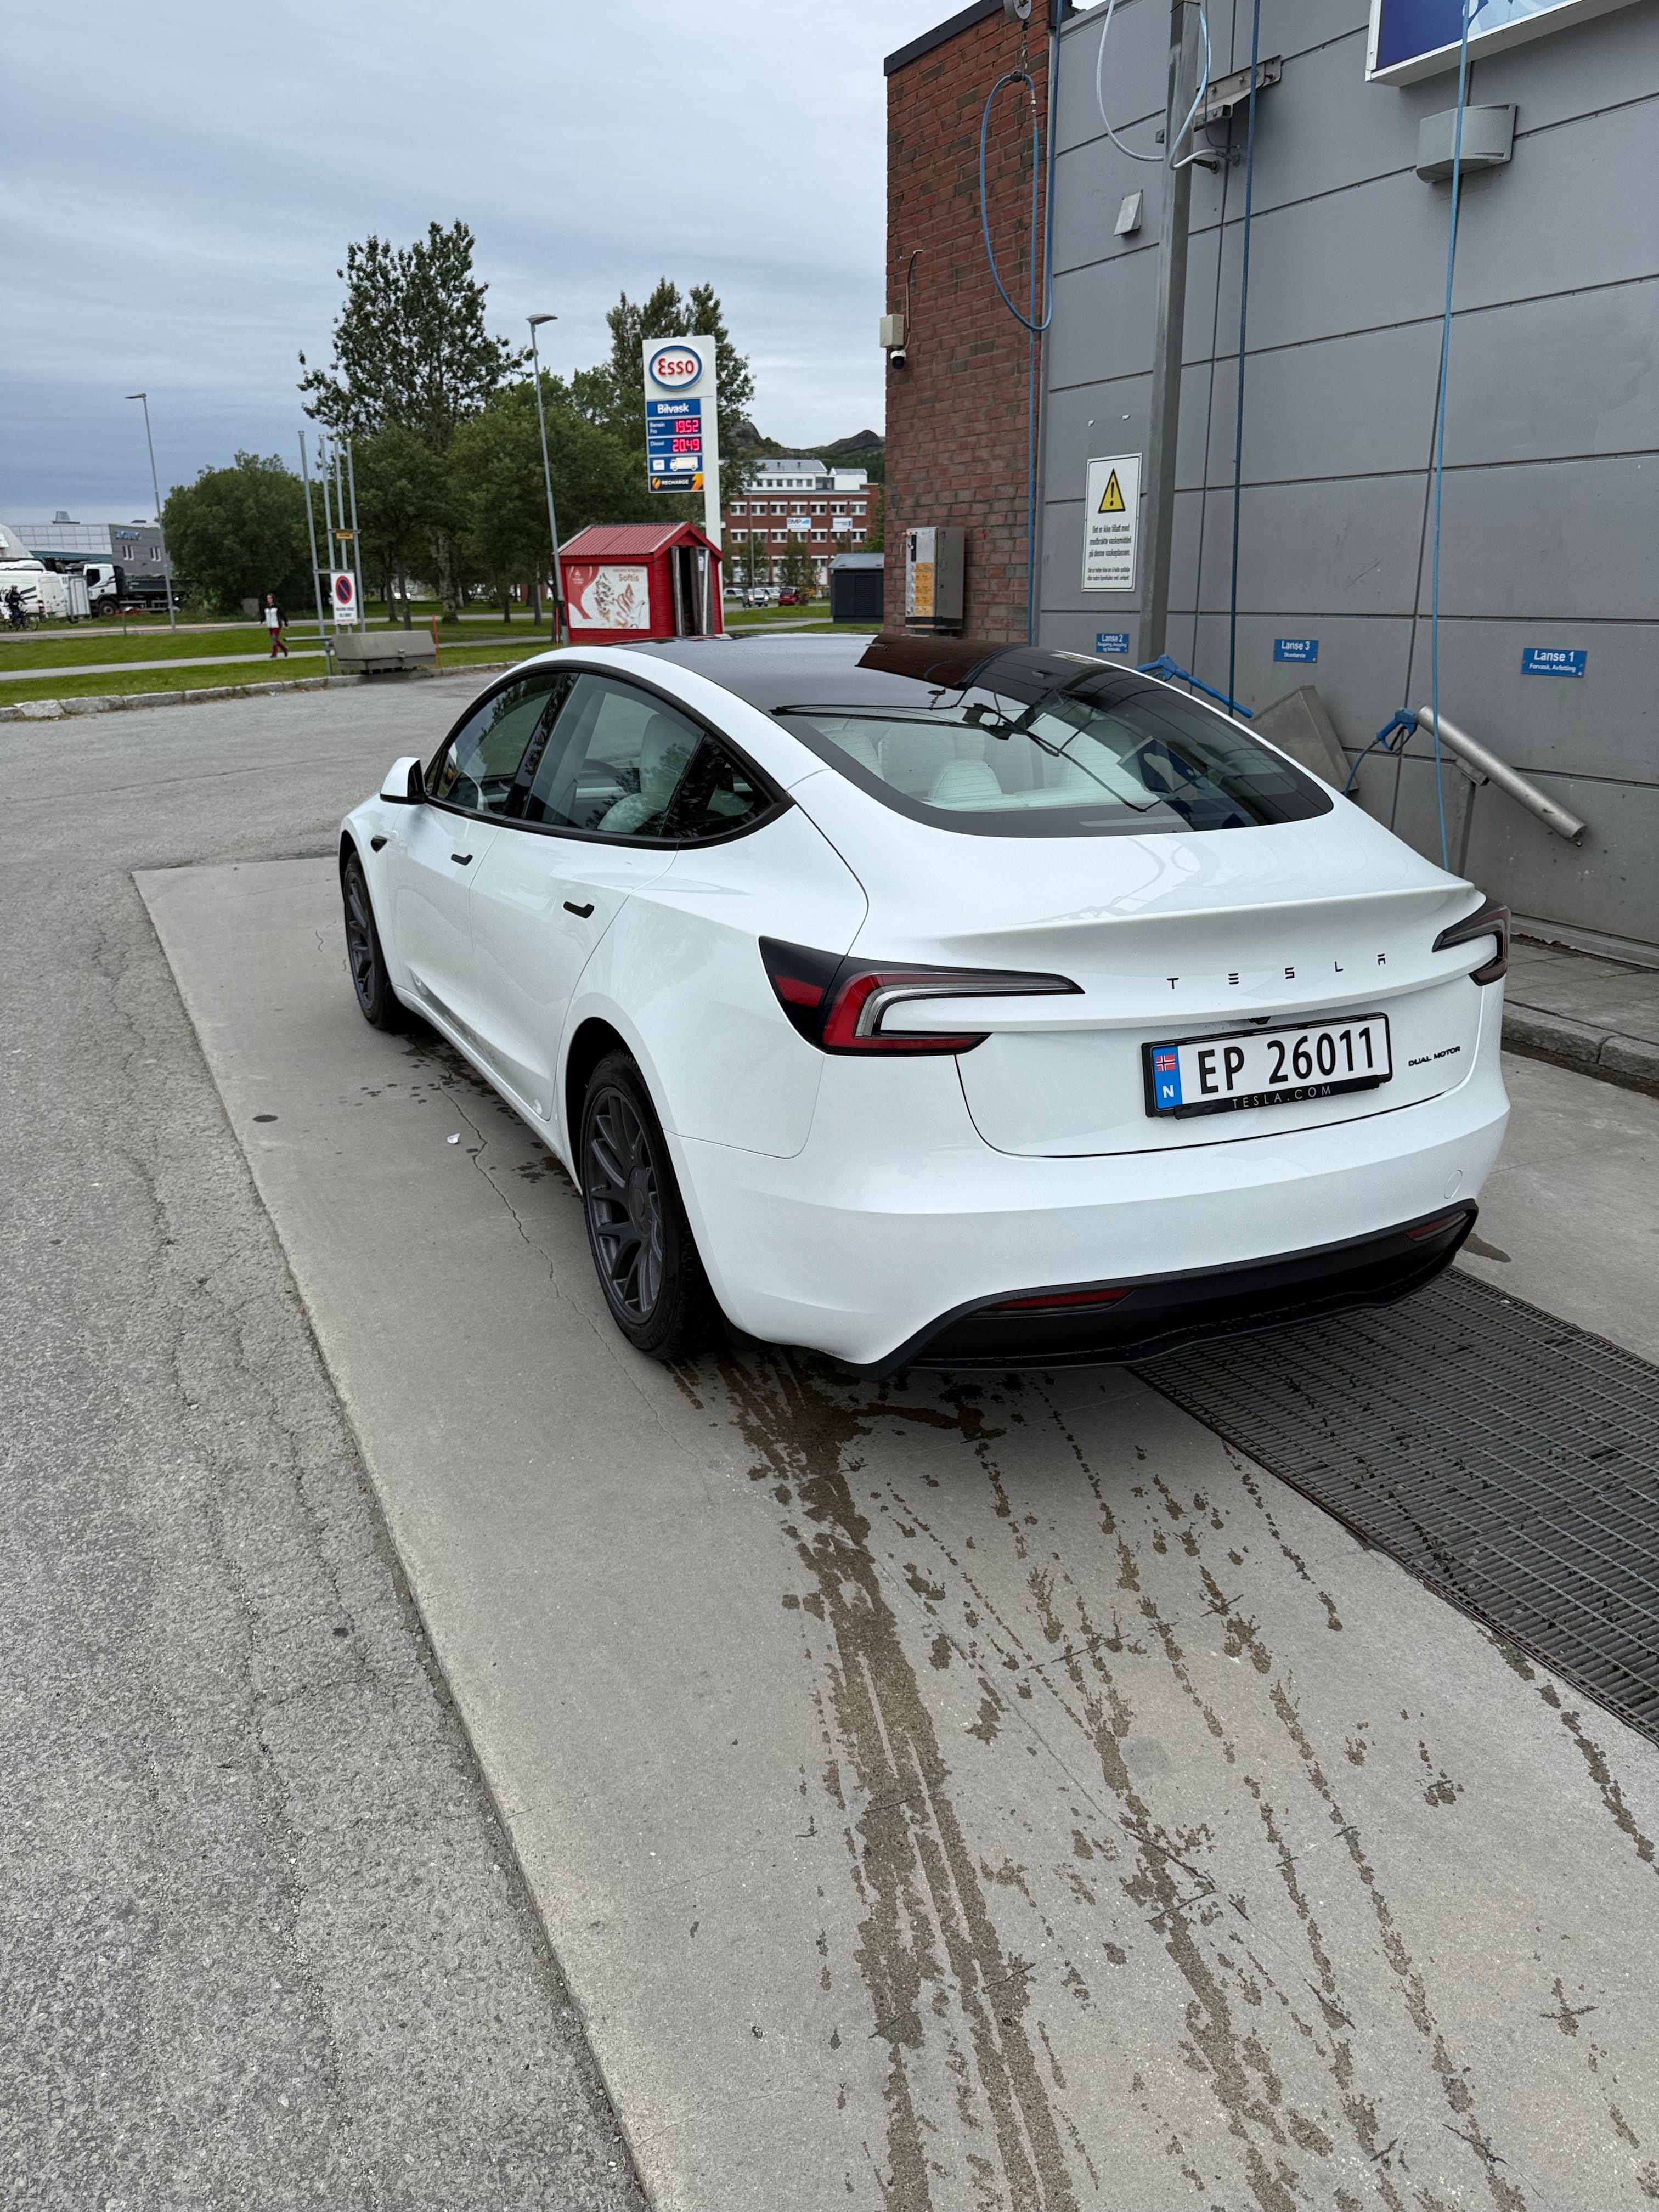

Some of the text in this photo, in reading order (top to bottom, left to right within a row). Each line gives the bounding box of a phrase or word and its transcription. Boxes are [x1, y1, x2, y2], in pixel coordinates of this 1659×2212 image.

[657, 403, 689, 414] Bilvask
[1101, 634, 1123, 642] Lanse 2
[1281, 640, 1310, 650] Lanse 3
[1534, 650, 1575, 662] Lanse 1
[1166, 953, 1386, 990] TESLA
[1198, 1026, 1373, 1094] EP 26011
[1408, 1046, 1461, 1066] DUAL MOTOR
[1162, 1084, 1174, 1098] N
[1232, 1085, 1332, 1109] TESLA.COM
